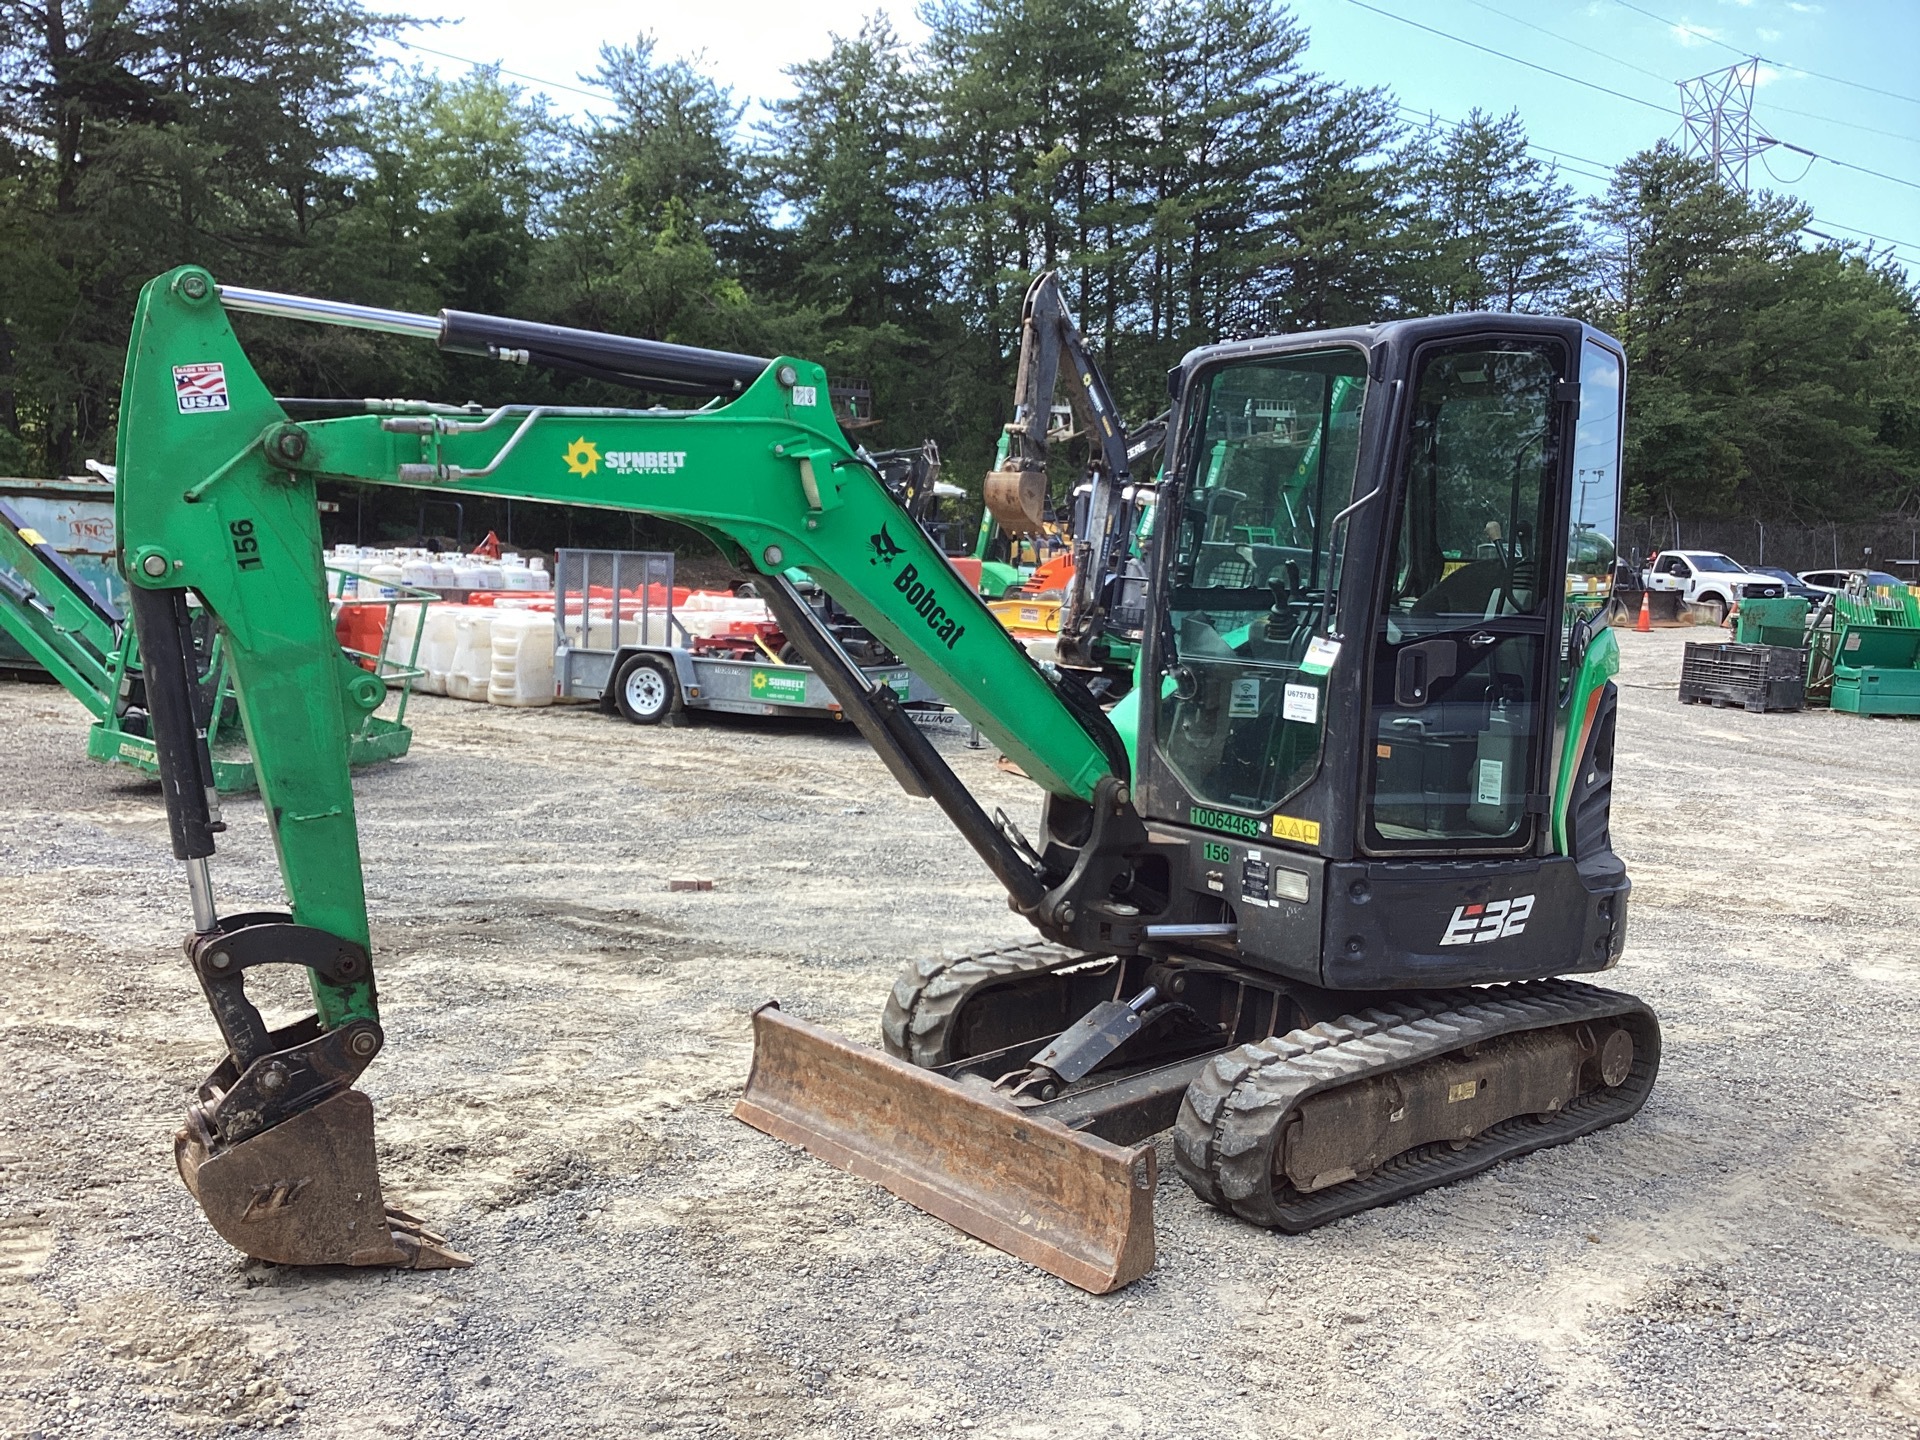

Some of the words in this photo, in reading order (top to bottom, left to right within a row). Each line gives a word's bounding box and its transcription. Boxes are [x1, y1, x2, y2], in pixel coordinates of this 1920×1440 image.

[181, 395, 225, 409] USA
[604, 451, 687, 468] SUNBELT
[230, 520, 260, 569] 156
[893, 562, 966, 650] Bobcat
[768, 677, 805, 689] SUNBELT
[1287, 690, 1316, 700] U675783
[1191, 807, 1259, 837] 10064463
[1205, 843, 1229, 863] 156
[1439, 894, 1536, 946] E32
